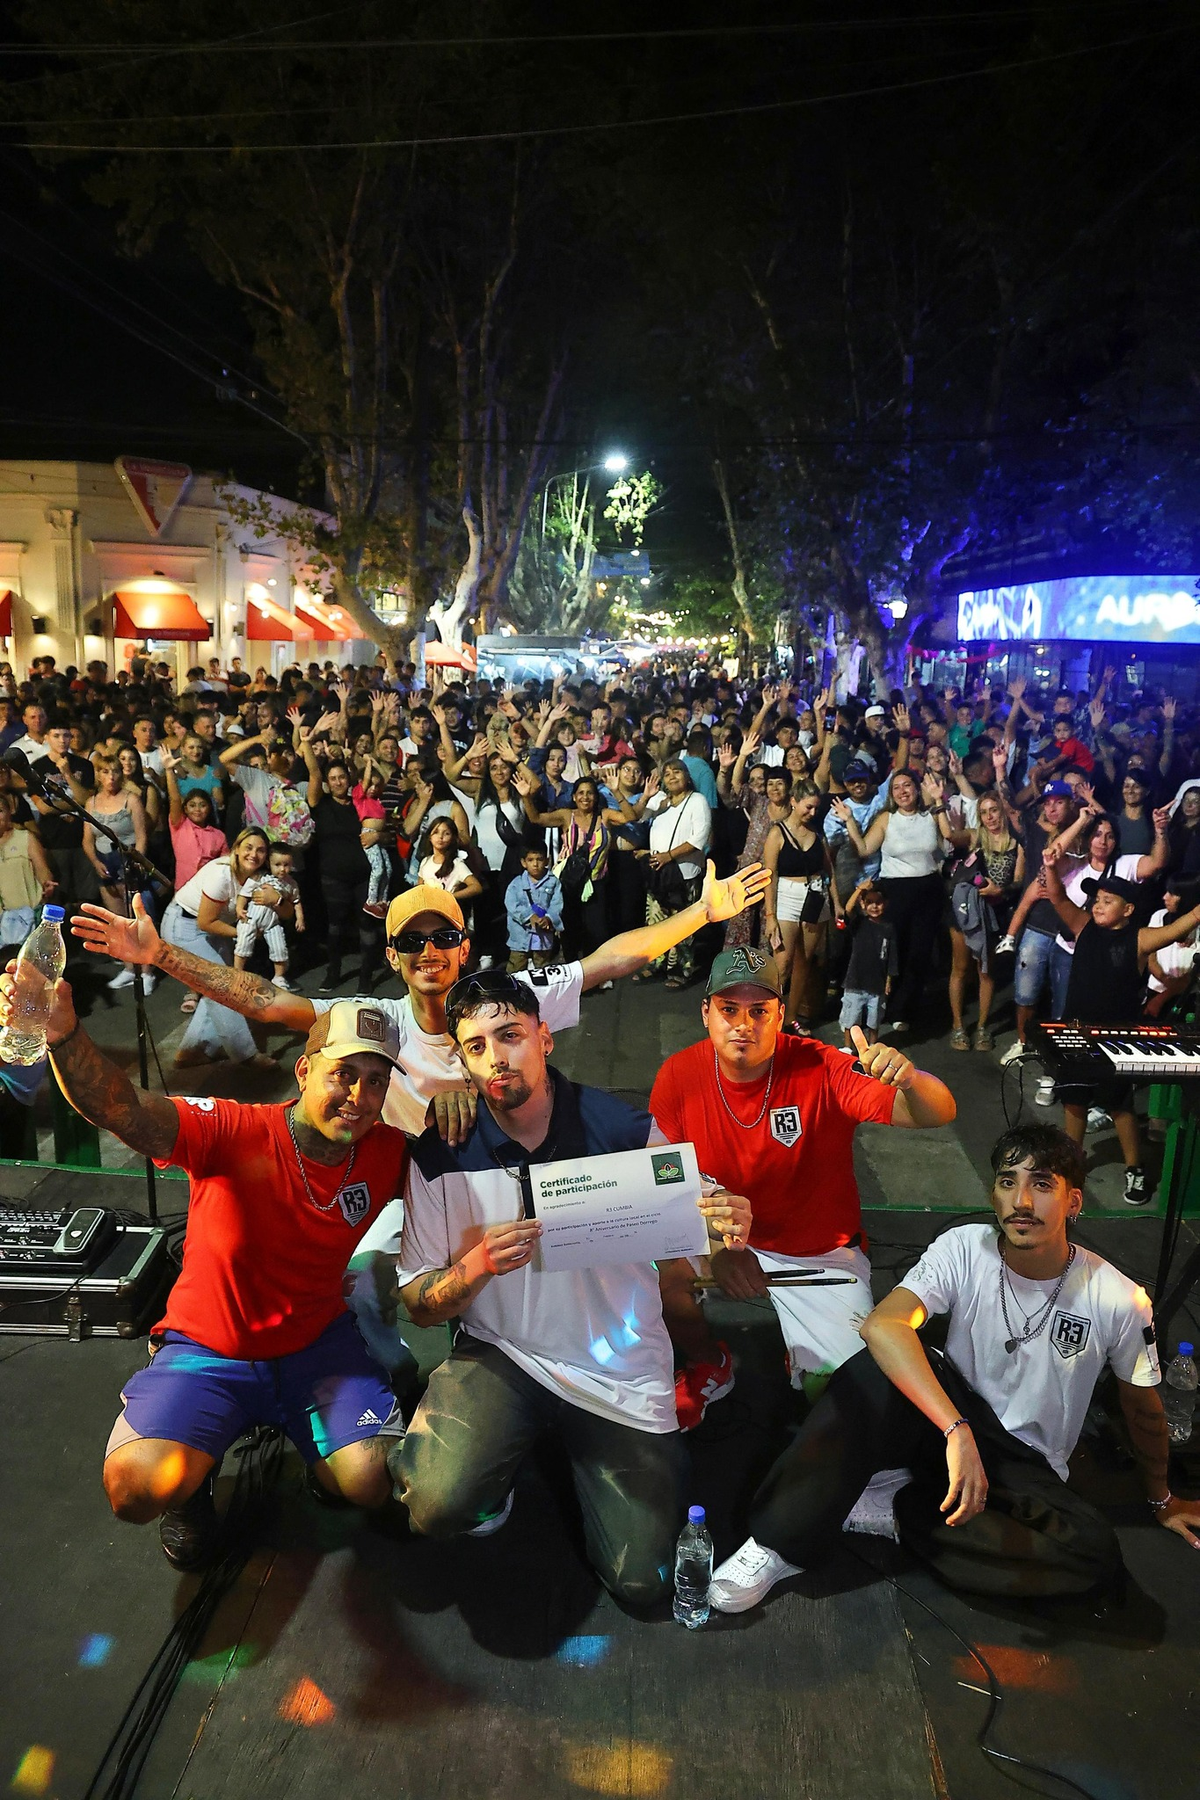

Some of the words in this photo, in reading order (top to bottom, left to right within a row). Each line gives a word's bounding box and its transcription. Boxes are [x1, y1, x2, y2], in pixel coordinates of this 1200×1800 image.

[773, 1112, 798, 1134] R3
[540, 1174, 592, 1189] Certificado
[541, 1190, 554, 1198] de
[555, 1180, 618, 1197] participación
[342, 1189, 367, 1213] R3
[1058, 1318, 1084, 1344] R3
[356, 1418, 383, 1427] adidas
